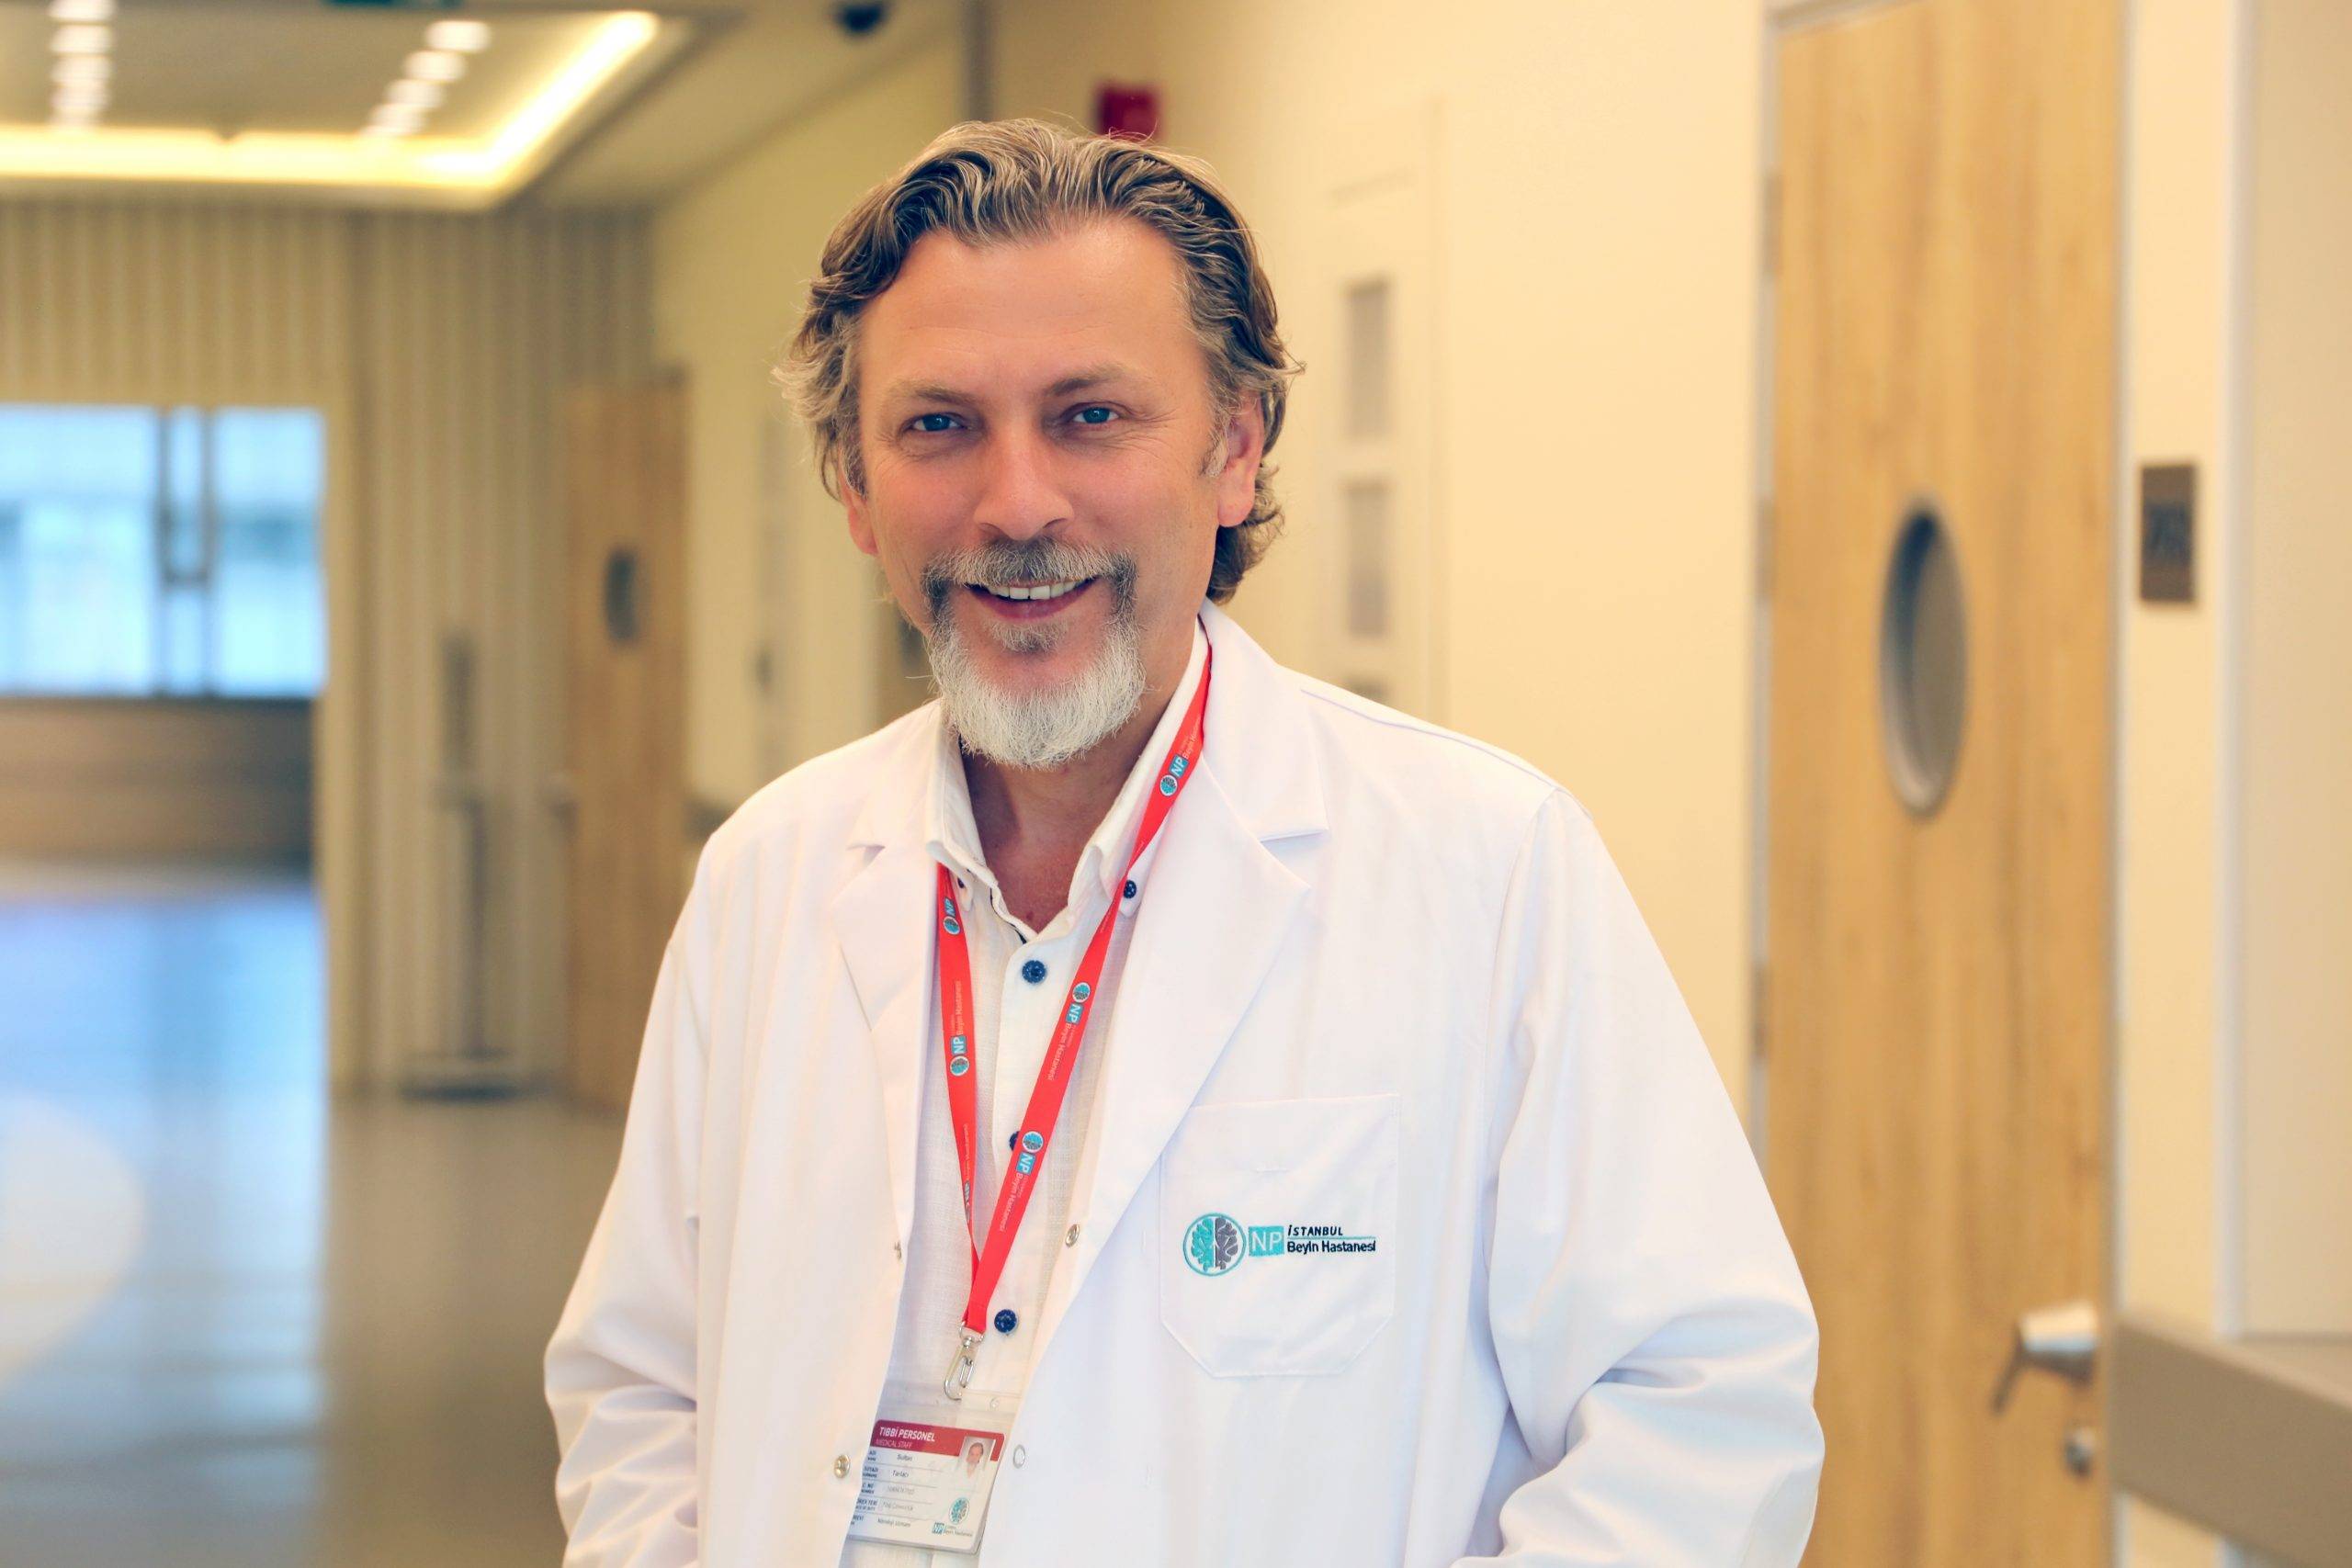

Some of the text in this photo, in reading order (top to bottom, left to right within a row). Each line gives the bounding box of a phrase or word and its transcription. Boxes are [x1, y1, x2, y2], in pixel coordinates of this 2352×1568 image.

[1170, 755, 1186, 777] NP
[1068, 1004, 1081, 1023] NP
[953, 1036, 965, 1054] NP
[1019, 1153, 1033, 1173] NP
[1250, 1229, 1283, 1253] NP
[898, 1440, 912, 1449] STAFF
[899, 1429, 935, 1442] PERSONEL
